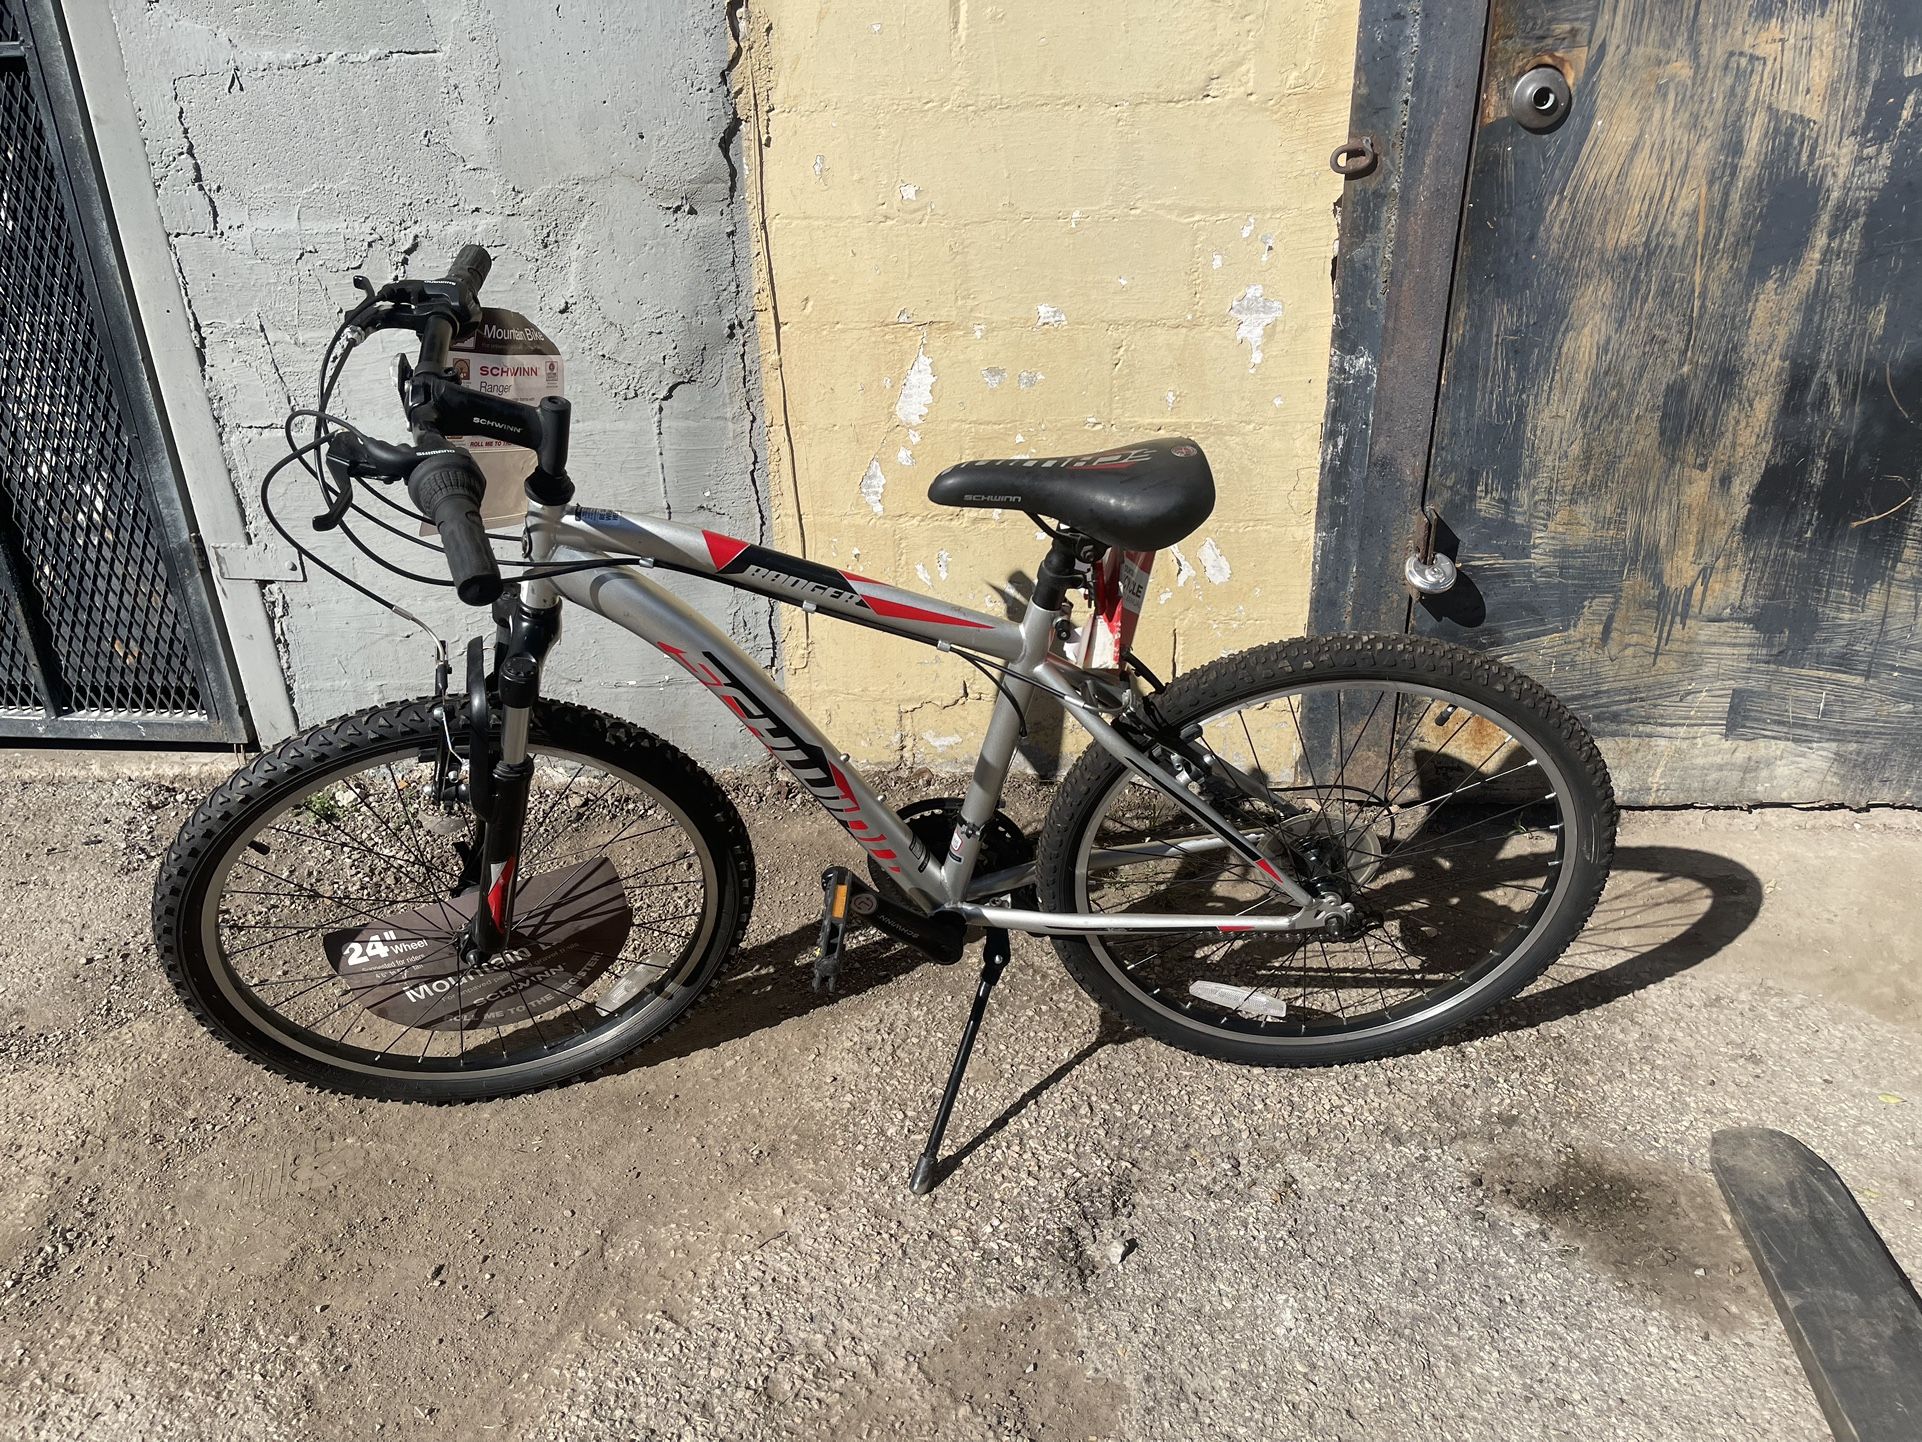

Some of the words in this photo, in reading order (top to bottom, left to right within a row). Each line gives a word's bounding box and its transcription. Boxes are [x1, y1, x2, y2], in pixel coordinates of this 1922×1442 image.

[483, 324, 526, 341] Mountain
[525, 327, 545, 341] Bike
[479, 365, 538, 377] SCHWINN
[480, 380, 512, 395] Ranger
[472, 416, 522, 433] SCHWINN
[963, 494, 1022, 503] SCHWINN
[743, 564, 869, 610] RANGER
[343, 930, 397, 966] 24"
[390, 938, 429, 954] Wheel
[406, 953, 425, 964] riders
[473, 964, 563, 1007] SCHWINN
[483, 1010, 504, 1020] ME
[508, 1004, 526, 1014] TO
[527, 993, 555, 1008] THE
